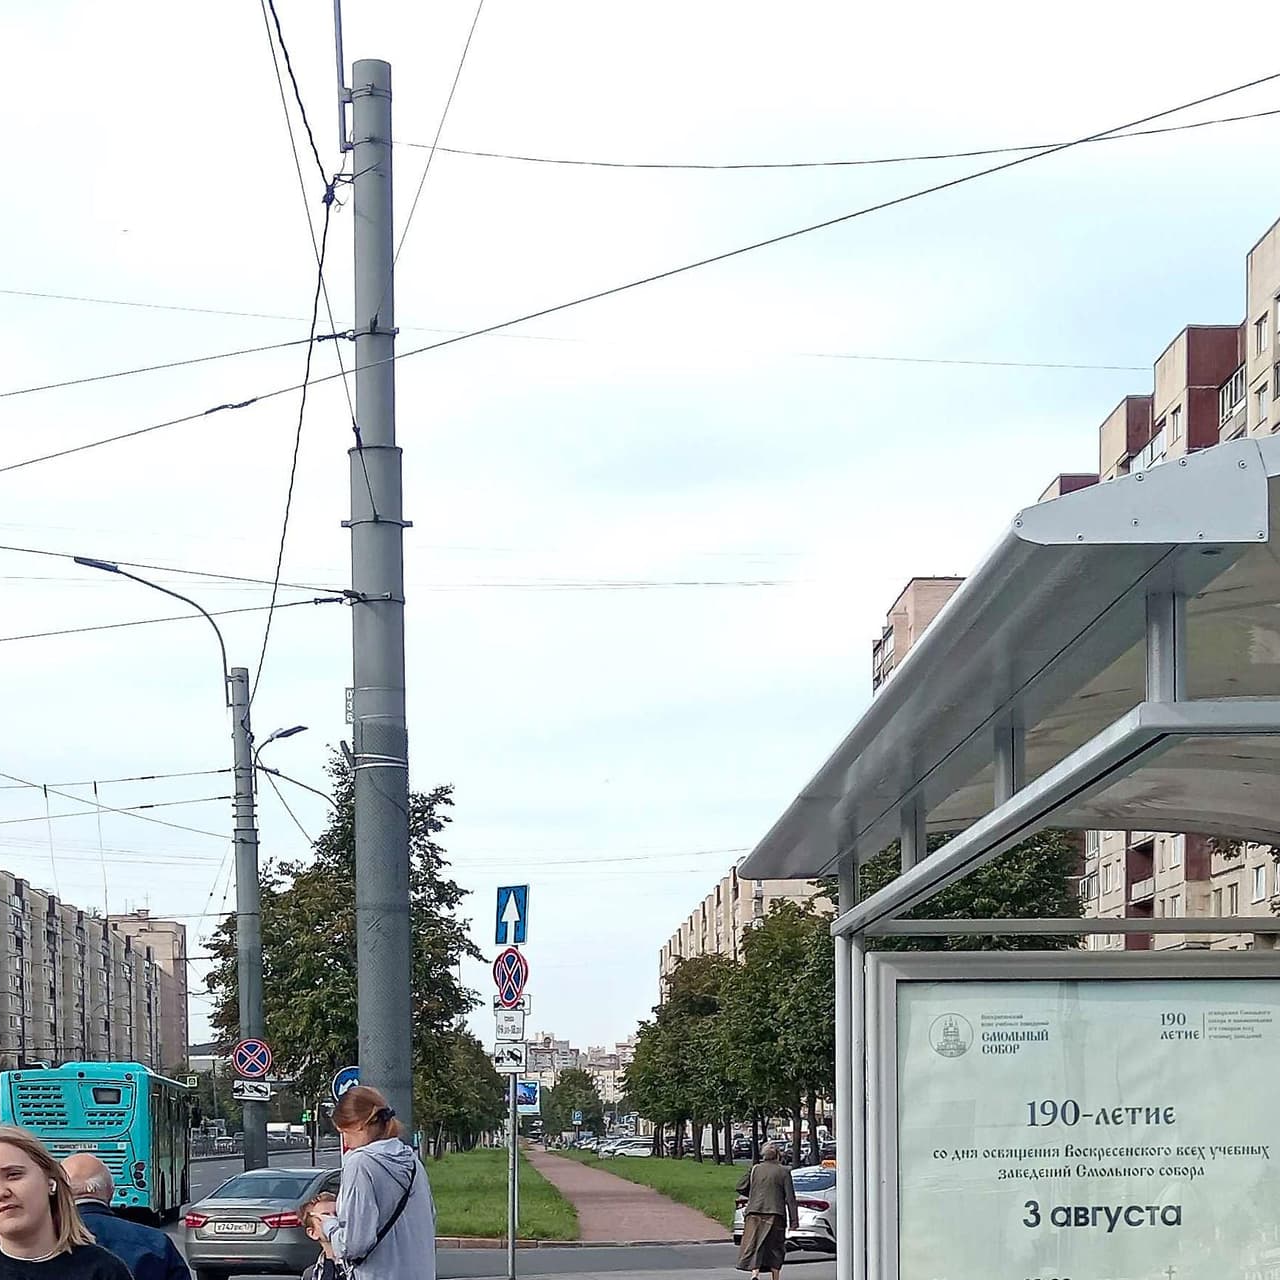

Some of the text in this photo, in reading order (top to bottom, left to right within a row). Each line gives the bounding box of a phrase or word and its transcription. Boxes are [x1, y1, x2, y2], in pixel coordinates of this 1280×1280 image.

[1161, 1013, 1186, 1026] 190
[981, 1028, 1049, 1042] СМОЛЬНЫЙ
[982, 1044, 1020, 1055] СОБОР
[933, 1144, 1270, 1162] со дня освящения Воскресенского всех учебных
[998, 1164, 1205, 1181] заведений Смольного собора
[1022, 1200, 1182, 1233] 3 августа
